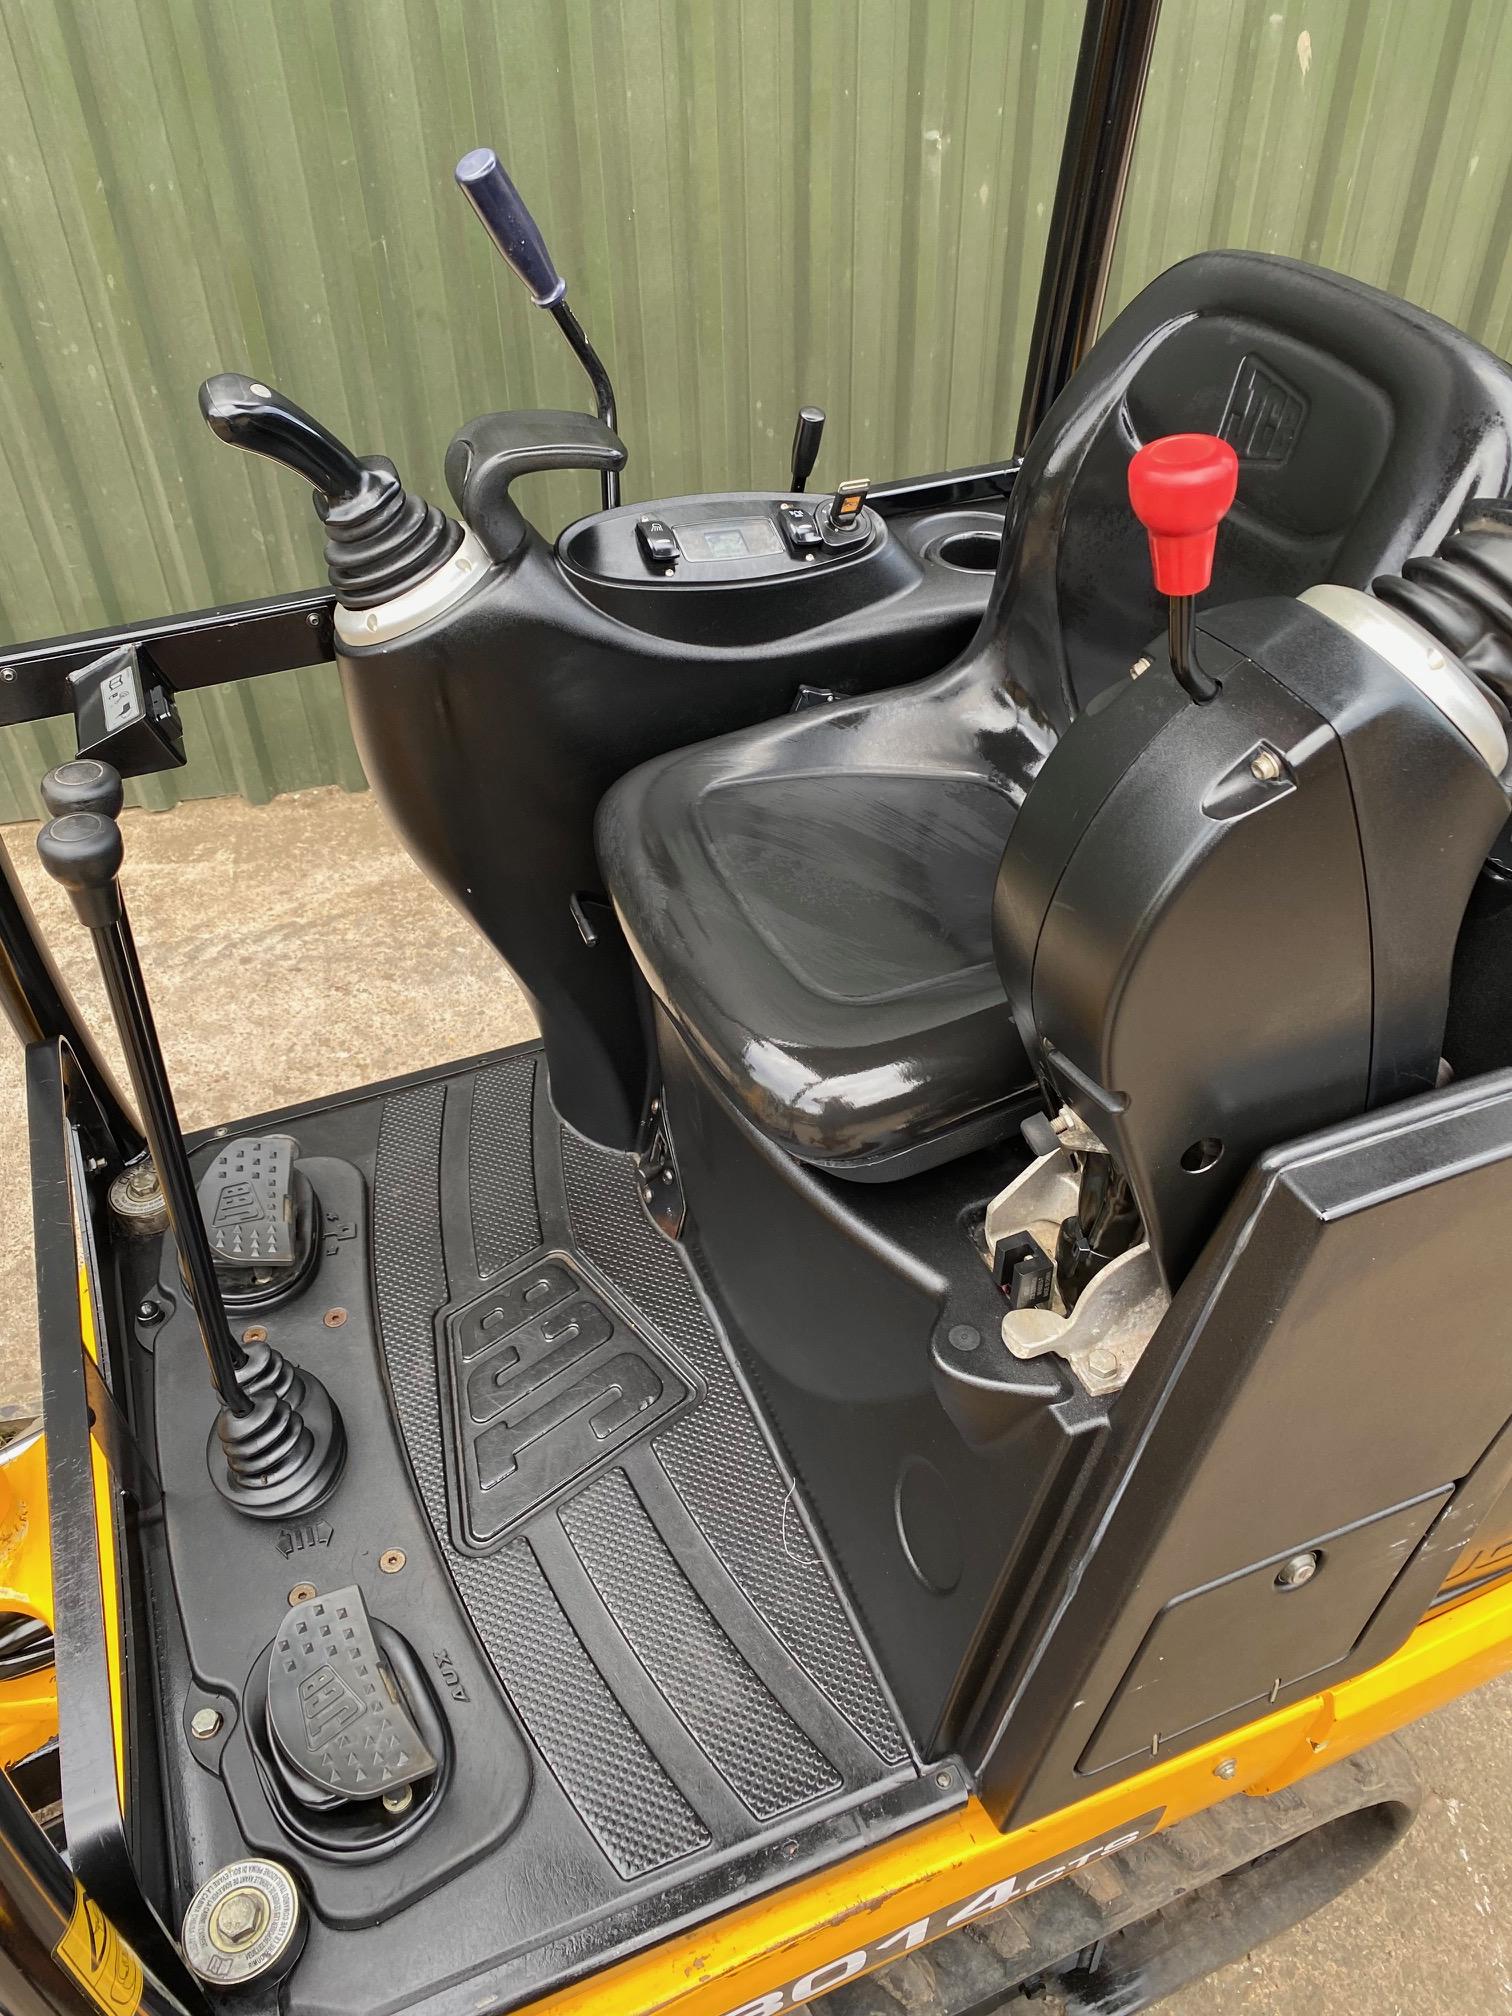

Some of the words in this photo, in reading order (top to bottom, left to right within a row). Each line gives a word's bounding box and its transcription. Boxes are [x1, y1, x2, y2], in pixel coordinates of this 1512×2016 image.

[216, 1183, 259, 1222] JCB
[459, 1262, 664, 1491] JCB
[301, 1666, 359, 1739] JCB
[432, 1648, 471, 1702] AUX
[1026, 1830, 1140, 1892] CTS
